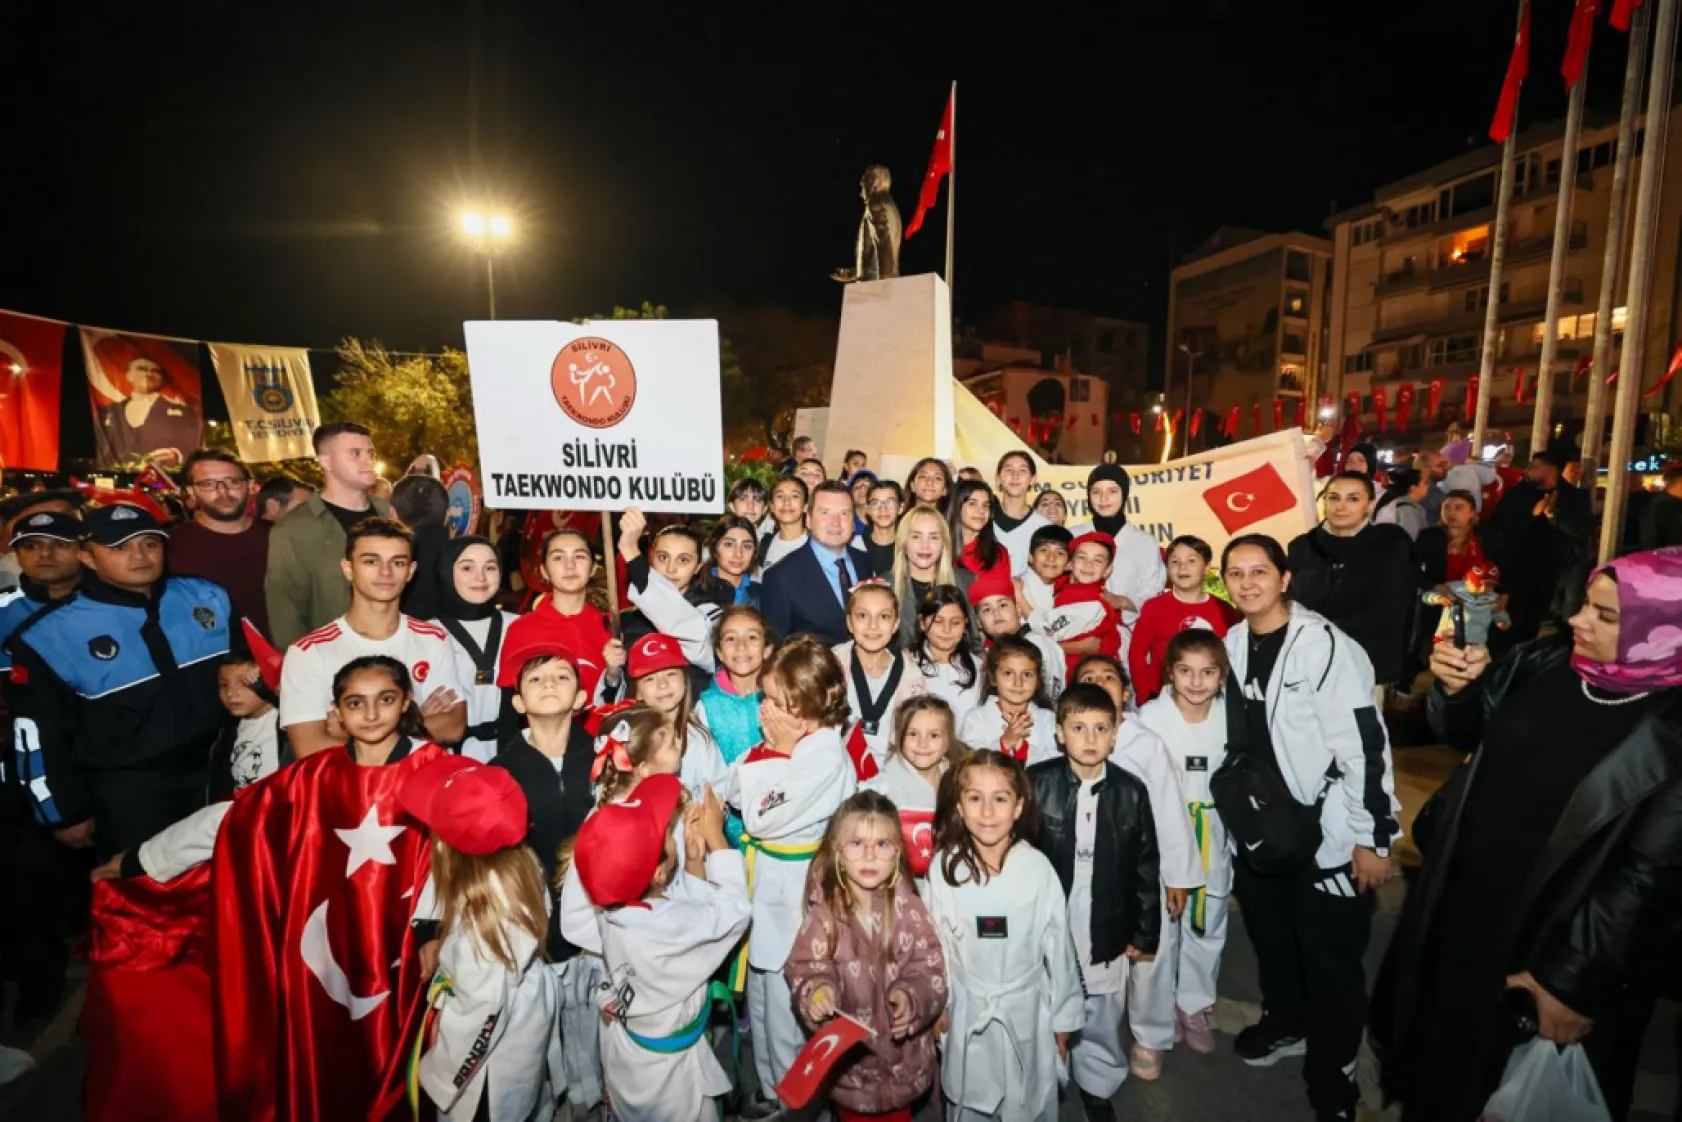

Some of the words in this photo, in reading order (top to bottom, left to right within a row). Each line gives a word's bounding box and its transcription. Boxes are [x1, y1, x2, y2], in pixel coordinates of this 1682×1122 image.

[571, 341, 611, 352] SİLİVRİ
[561, 395, 606, 425] TAEKWONDO
[607, 395, 631, 422] KULÜBÜ
[563, 438, 637, 468] SİLİVRİ
[491, 473, 622, 499] TAEKWONDO
[629, 473, 715, 502] KULÜBÜ
